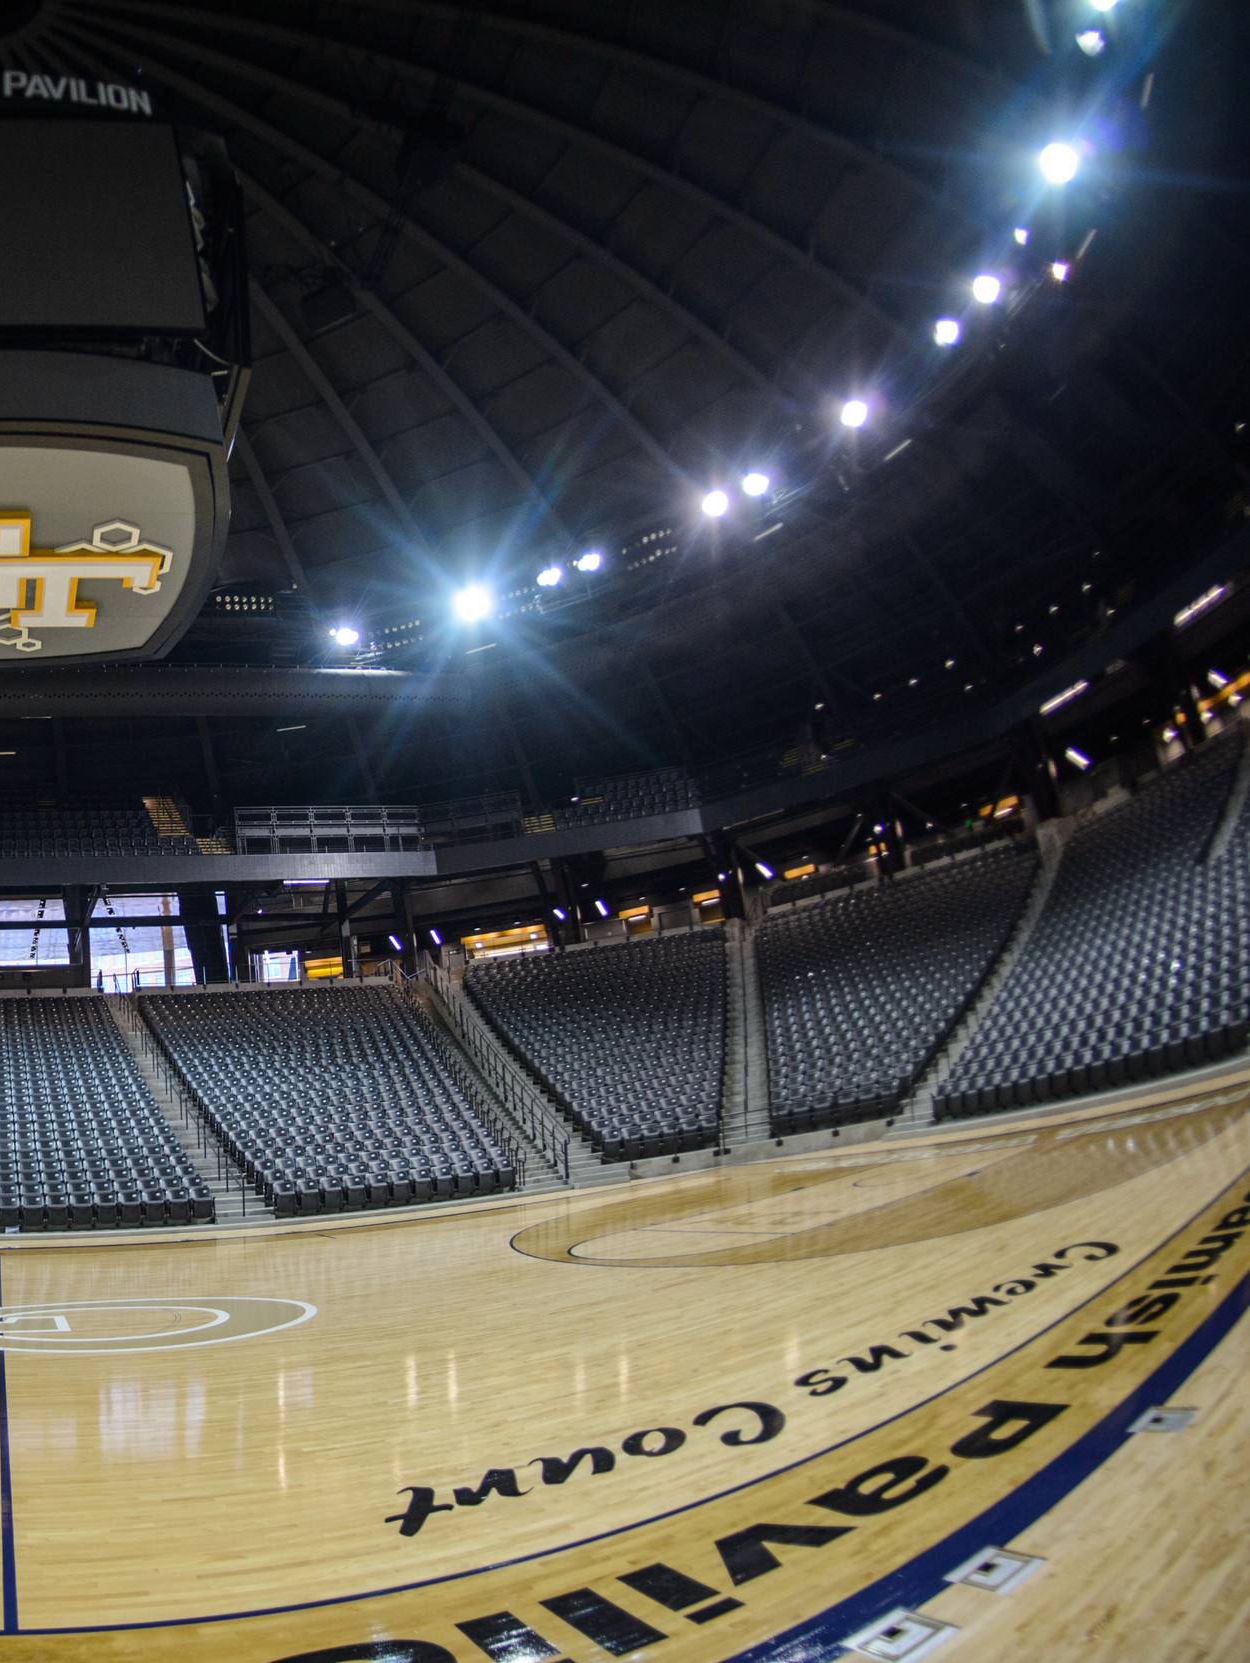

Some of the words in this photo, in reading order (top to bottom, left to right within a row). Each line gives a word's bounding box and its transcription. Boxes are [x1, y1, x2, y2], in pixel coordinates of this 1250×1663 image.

[2, 70, 153, 116] PAVILION
[794, 1241, 1120, 1398] Cremins
[1043, 1189, 1250, 1370] amish
[270, 1399, 1072, 1663] Pavili
[384, 1401, 786, 1537] Court
